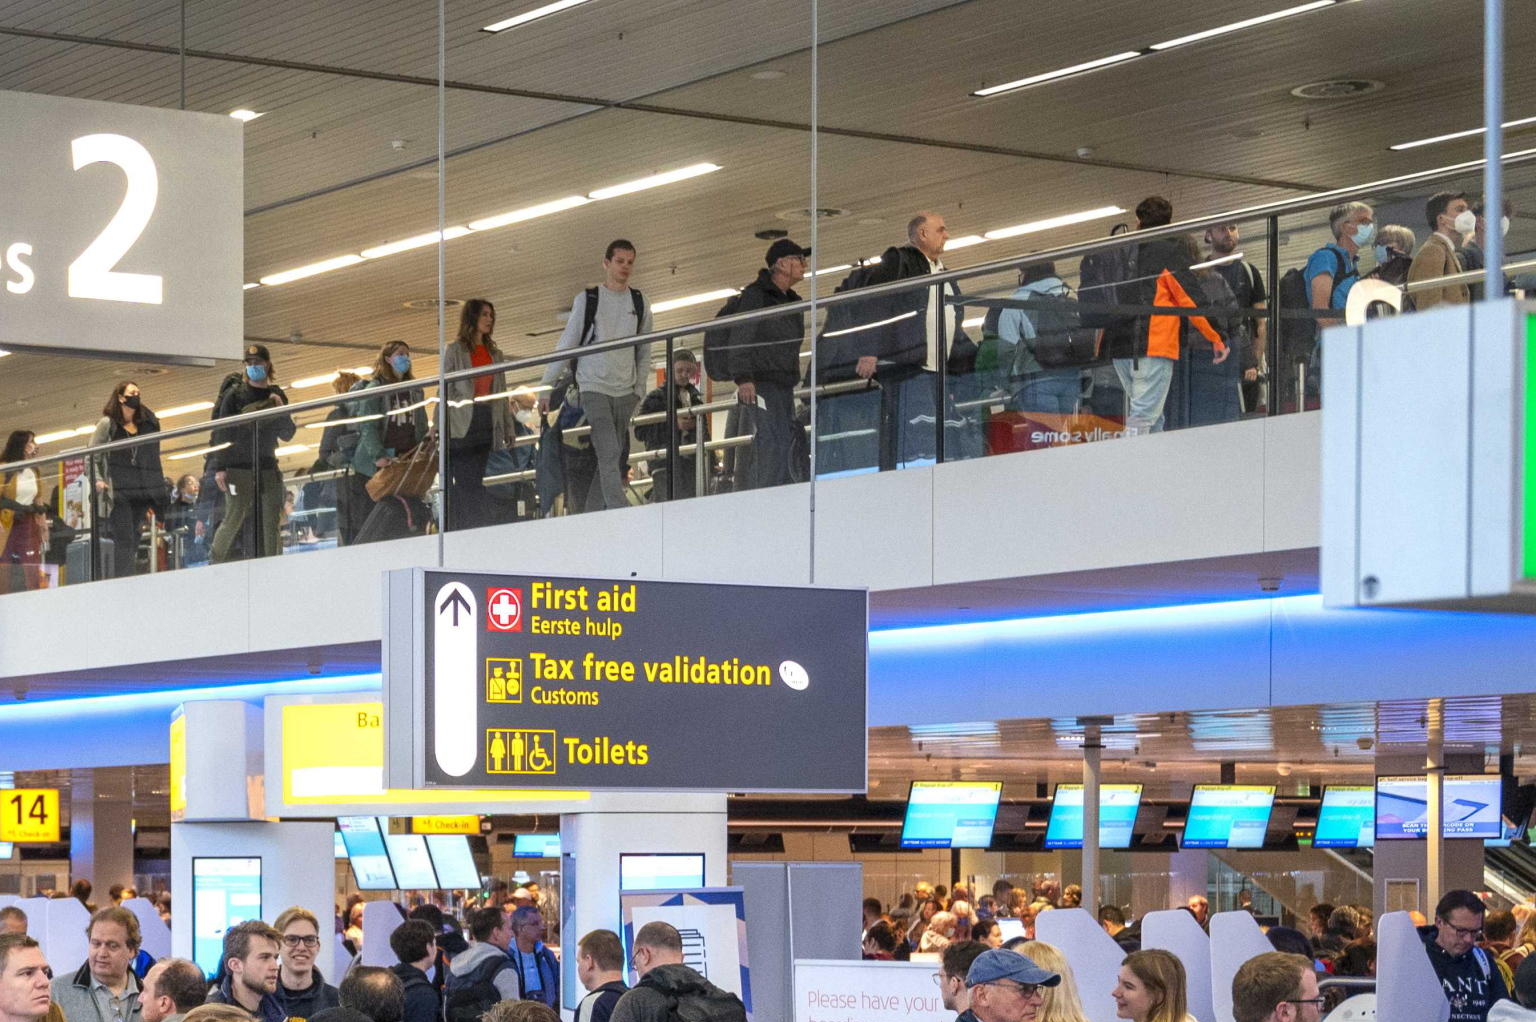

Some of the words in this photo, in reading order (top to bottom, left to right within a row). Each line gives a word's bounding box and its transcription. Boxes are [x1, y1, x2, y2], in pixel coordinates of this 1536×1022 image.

[68, 132, 164, 304] 2
[530, 581, 589, 612] First
[596, 585, 637, 613] aid
[531, 617, 581, 636] Eerste
[585, 618, 623, 640] hulp
[530, 653, 575, 680] Tax
[582, 653, 636, 683] free
[644, 656, 772, 687] validation
[530, 686, 600, 706] Customs
[563, 737, 649, 766] Toilets
[11, 794, 48, 825] 14
[435, 819, 470, 830] Check-in
[808, 990, 857, 1010] Please
[861, 992, 900, 1011] have
[904, 997, 939, 1017] your
